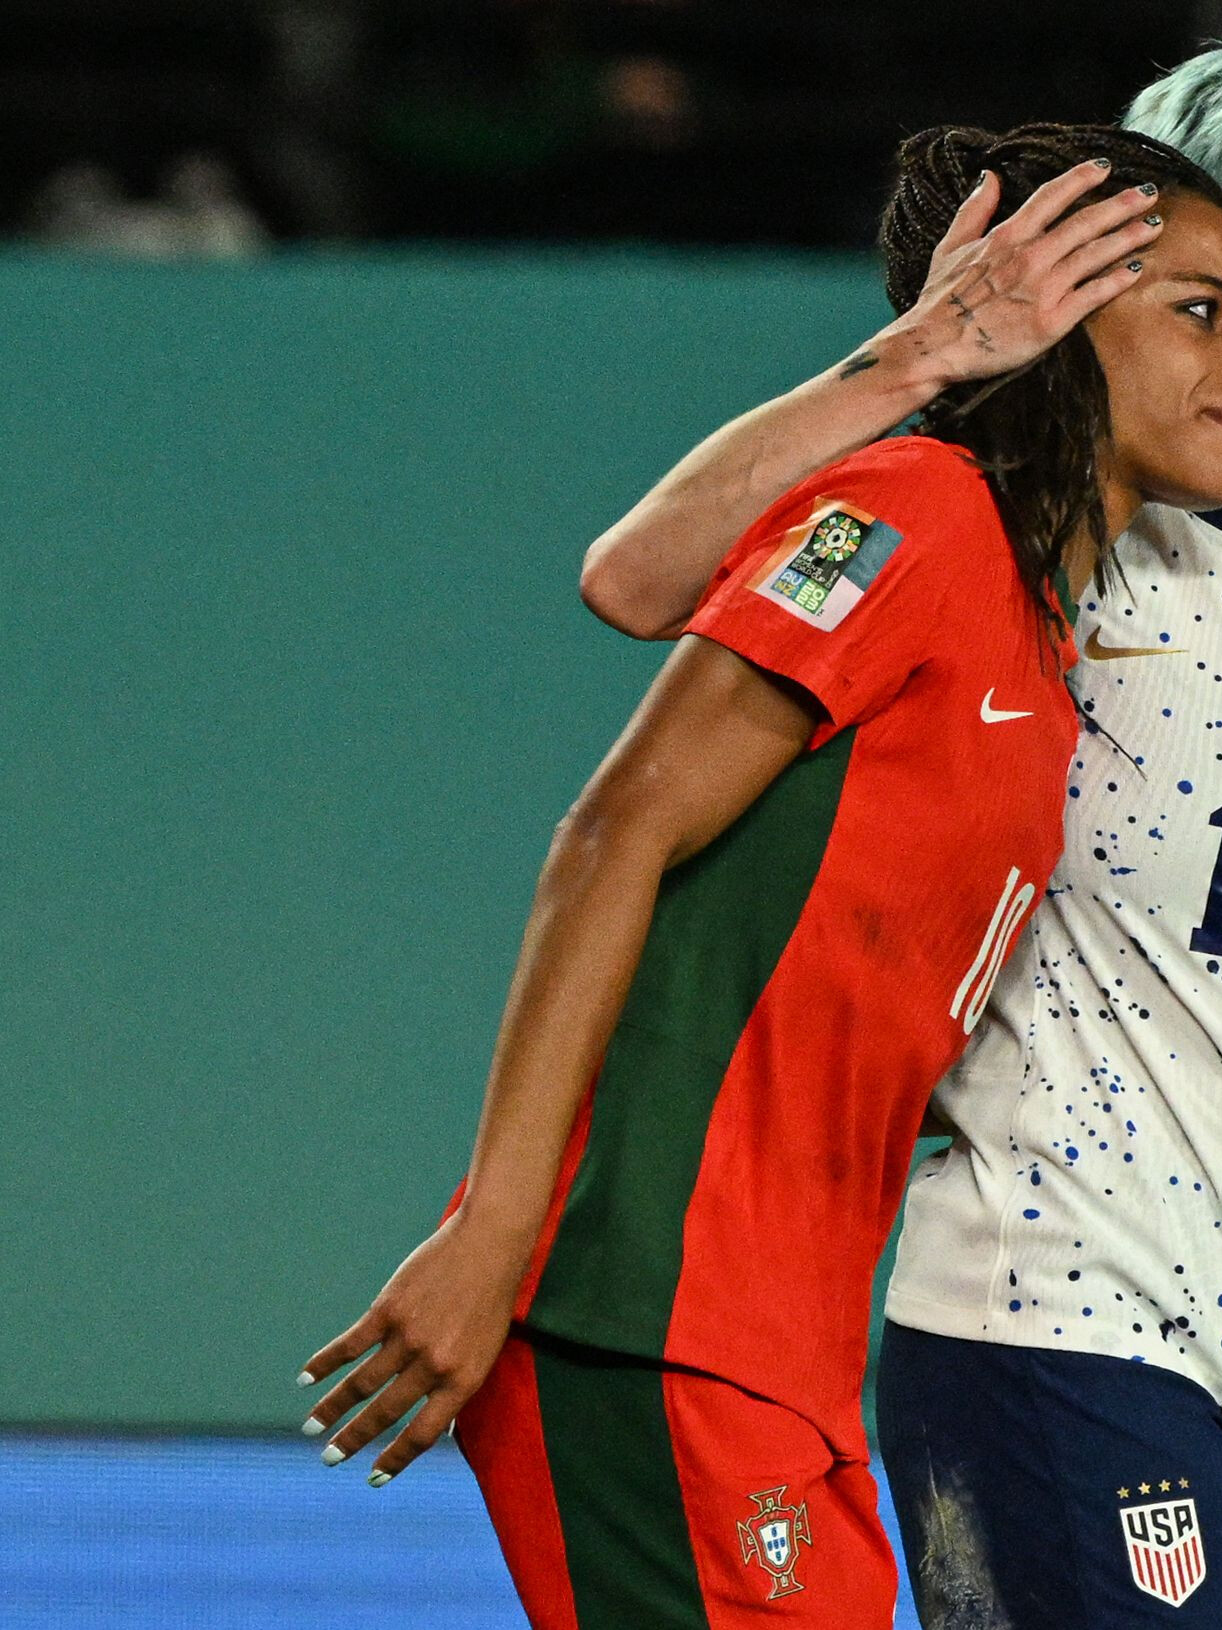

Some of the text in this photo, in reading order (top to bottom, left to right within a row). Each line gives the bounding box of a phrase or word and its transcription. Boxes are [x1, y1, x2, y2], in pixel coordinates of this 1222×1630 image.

[780, 571, 804, 586] AU
[810, 571, 826, 583] CUP
[774, 581, 797, 597] NZ
[949, 865, 1036, 1036] 10
[1127, 1504, 1194, 1547] USA
